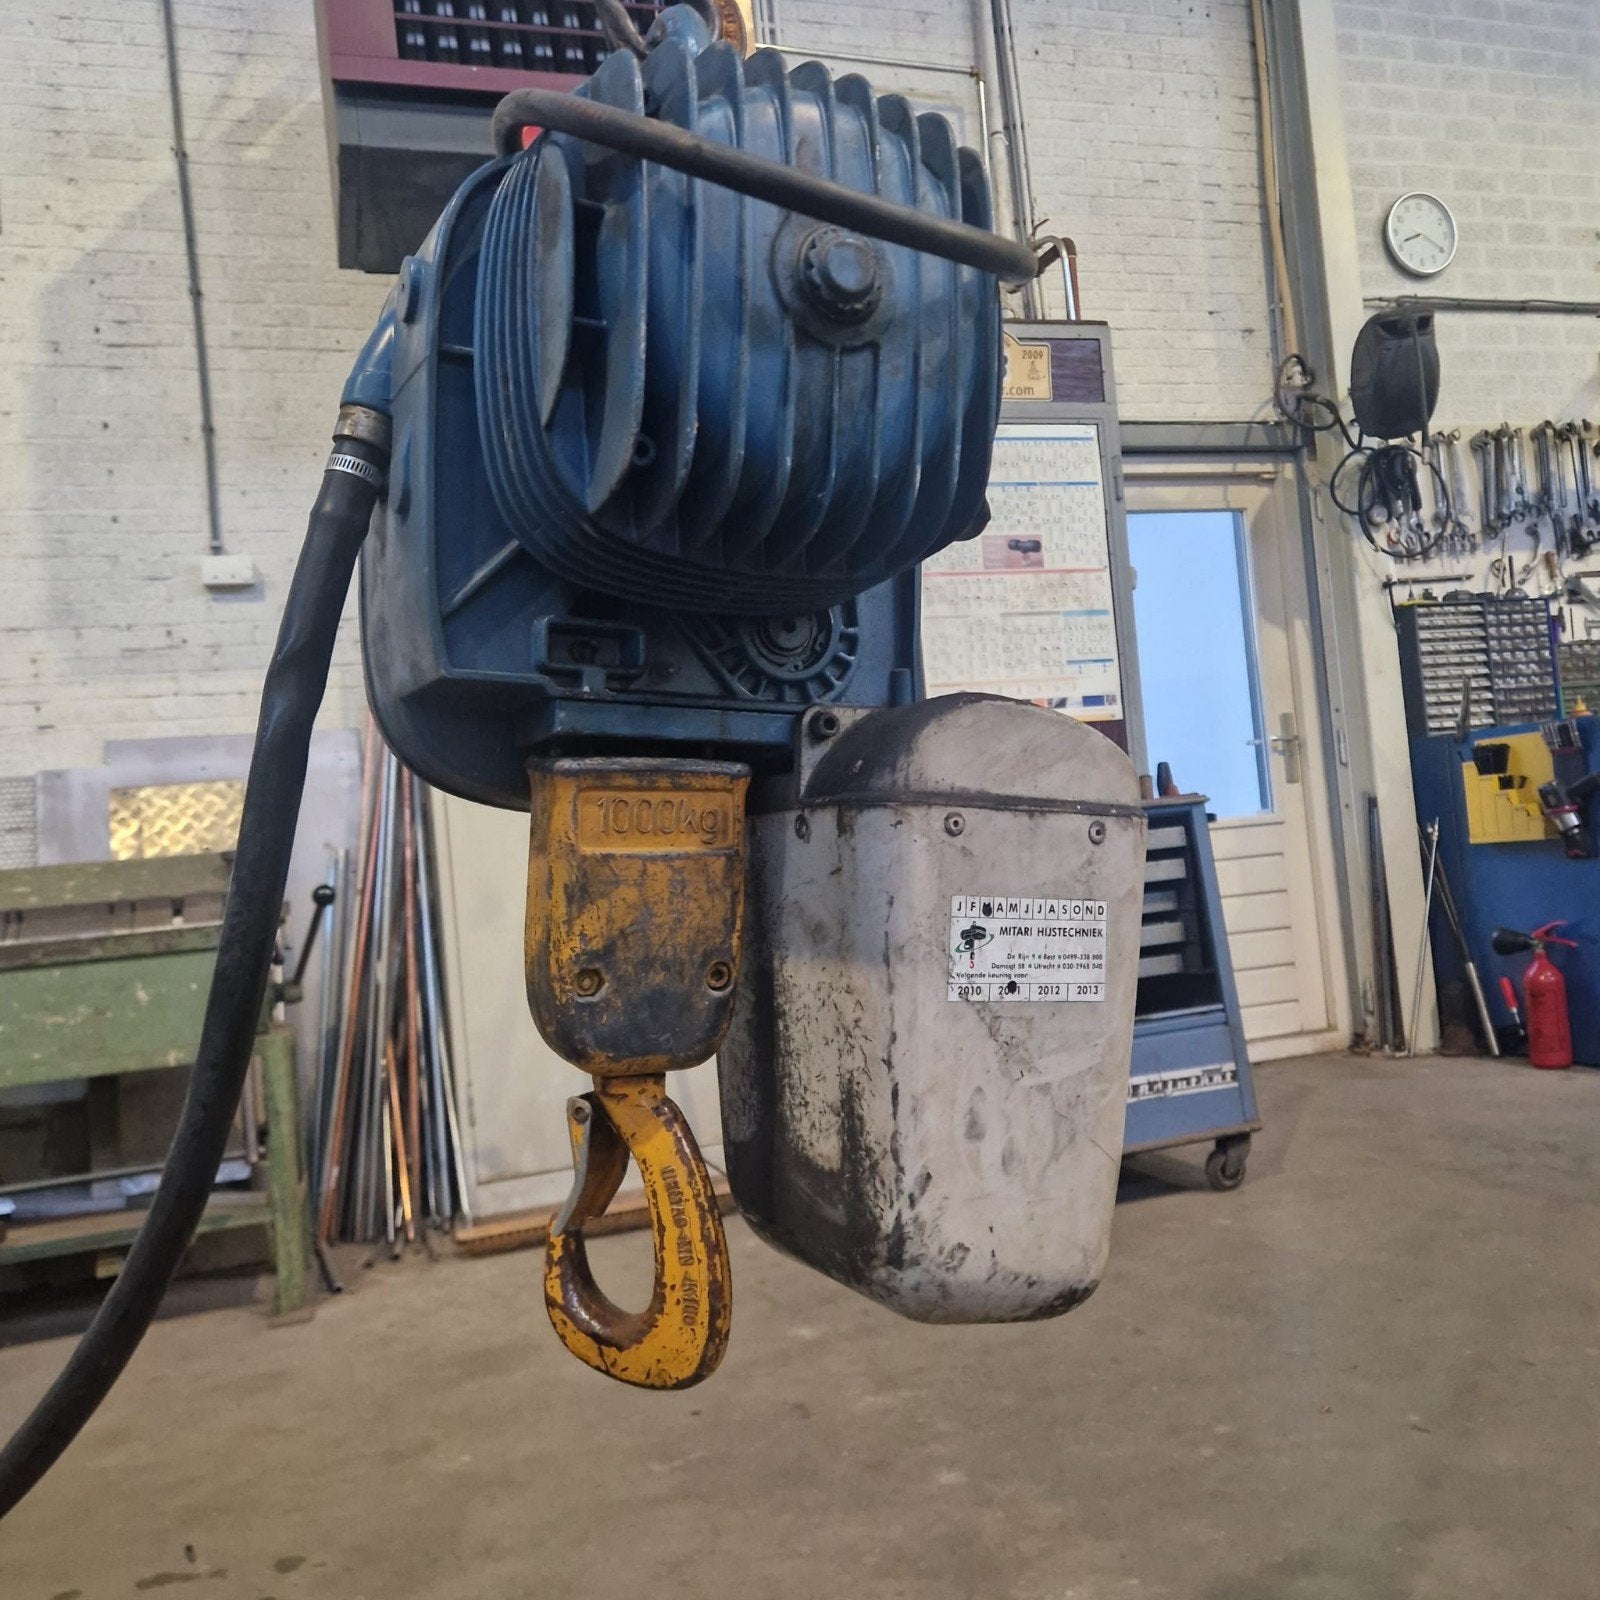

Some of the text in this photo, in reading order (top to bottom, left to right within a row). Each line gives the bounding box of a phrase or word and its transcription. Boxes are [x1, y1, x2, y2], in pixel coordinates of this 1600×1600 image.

[1022, 350, 1044, 360] 2009
[597, 797, 718, 844] 1000kg
[957, 901, 962, 911] J
[970, 901, 977, 911] F
[996, 902, 1004, 913] A
[1009, 903, 1018, 913] M
[1024, 904, 1029, 914] J
[1037, 904, 1042, 914] J
[1048, 904, 1056, 914] A
[1062, 905, 1068, 914] S
[1073, 905, 1081, 915] O
[1085, 905, 1093, 915] N
[1097, 906, 1105, 915] D
[999, 926, 1104, 938] MITARI HIJSTECHNIEK
[956, 972, 986, 980] Volgende
[988, 972, 1012, 980] keuring
[957, 985, 1099, 996] 2010 201 2012 2013
